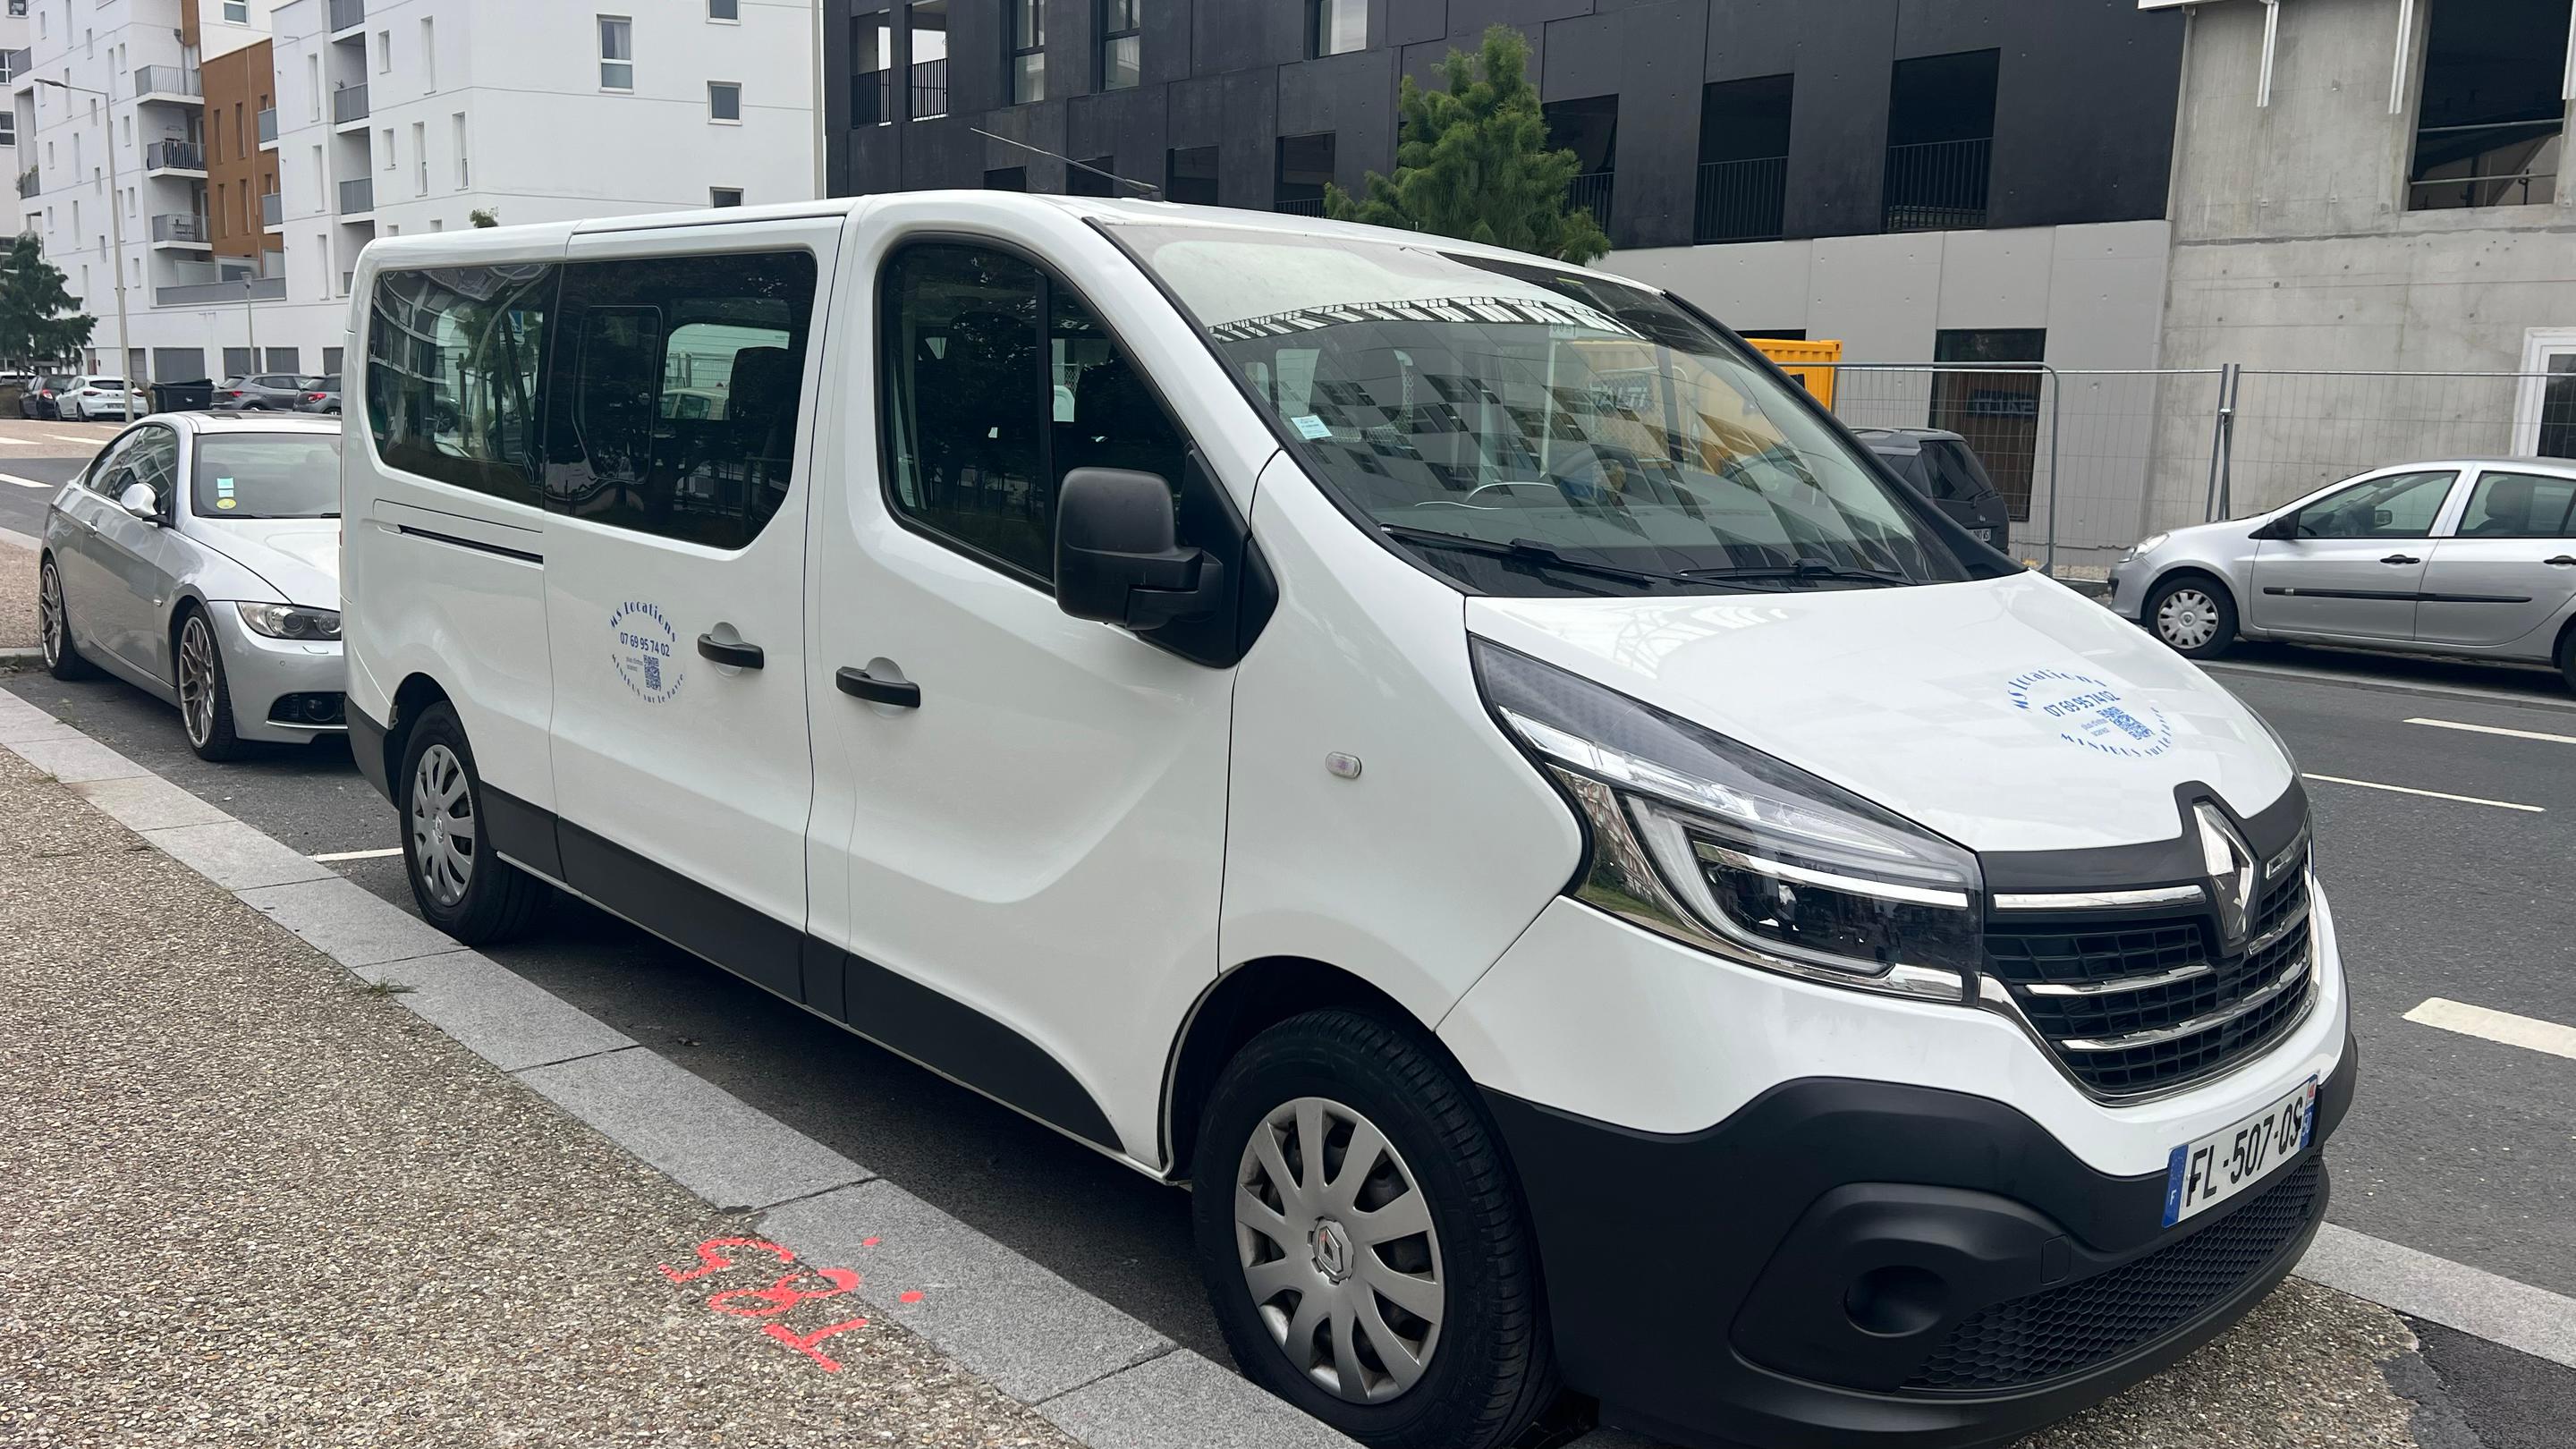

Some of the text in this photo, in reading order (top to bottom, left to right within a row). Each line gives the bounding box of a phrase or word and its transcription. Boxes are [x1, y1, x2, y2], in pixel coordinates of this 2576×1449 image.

[620, 631, 671, 657] 07 69 95 74 02
[2043, 690, 2122, 717] 07 69 95 74 02
[2169, 1189, 2176, 1206] F
